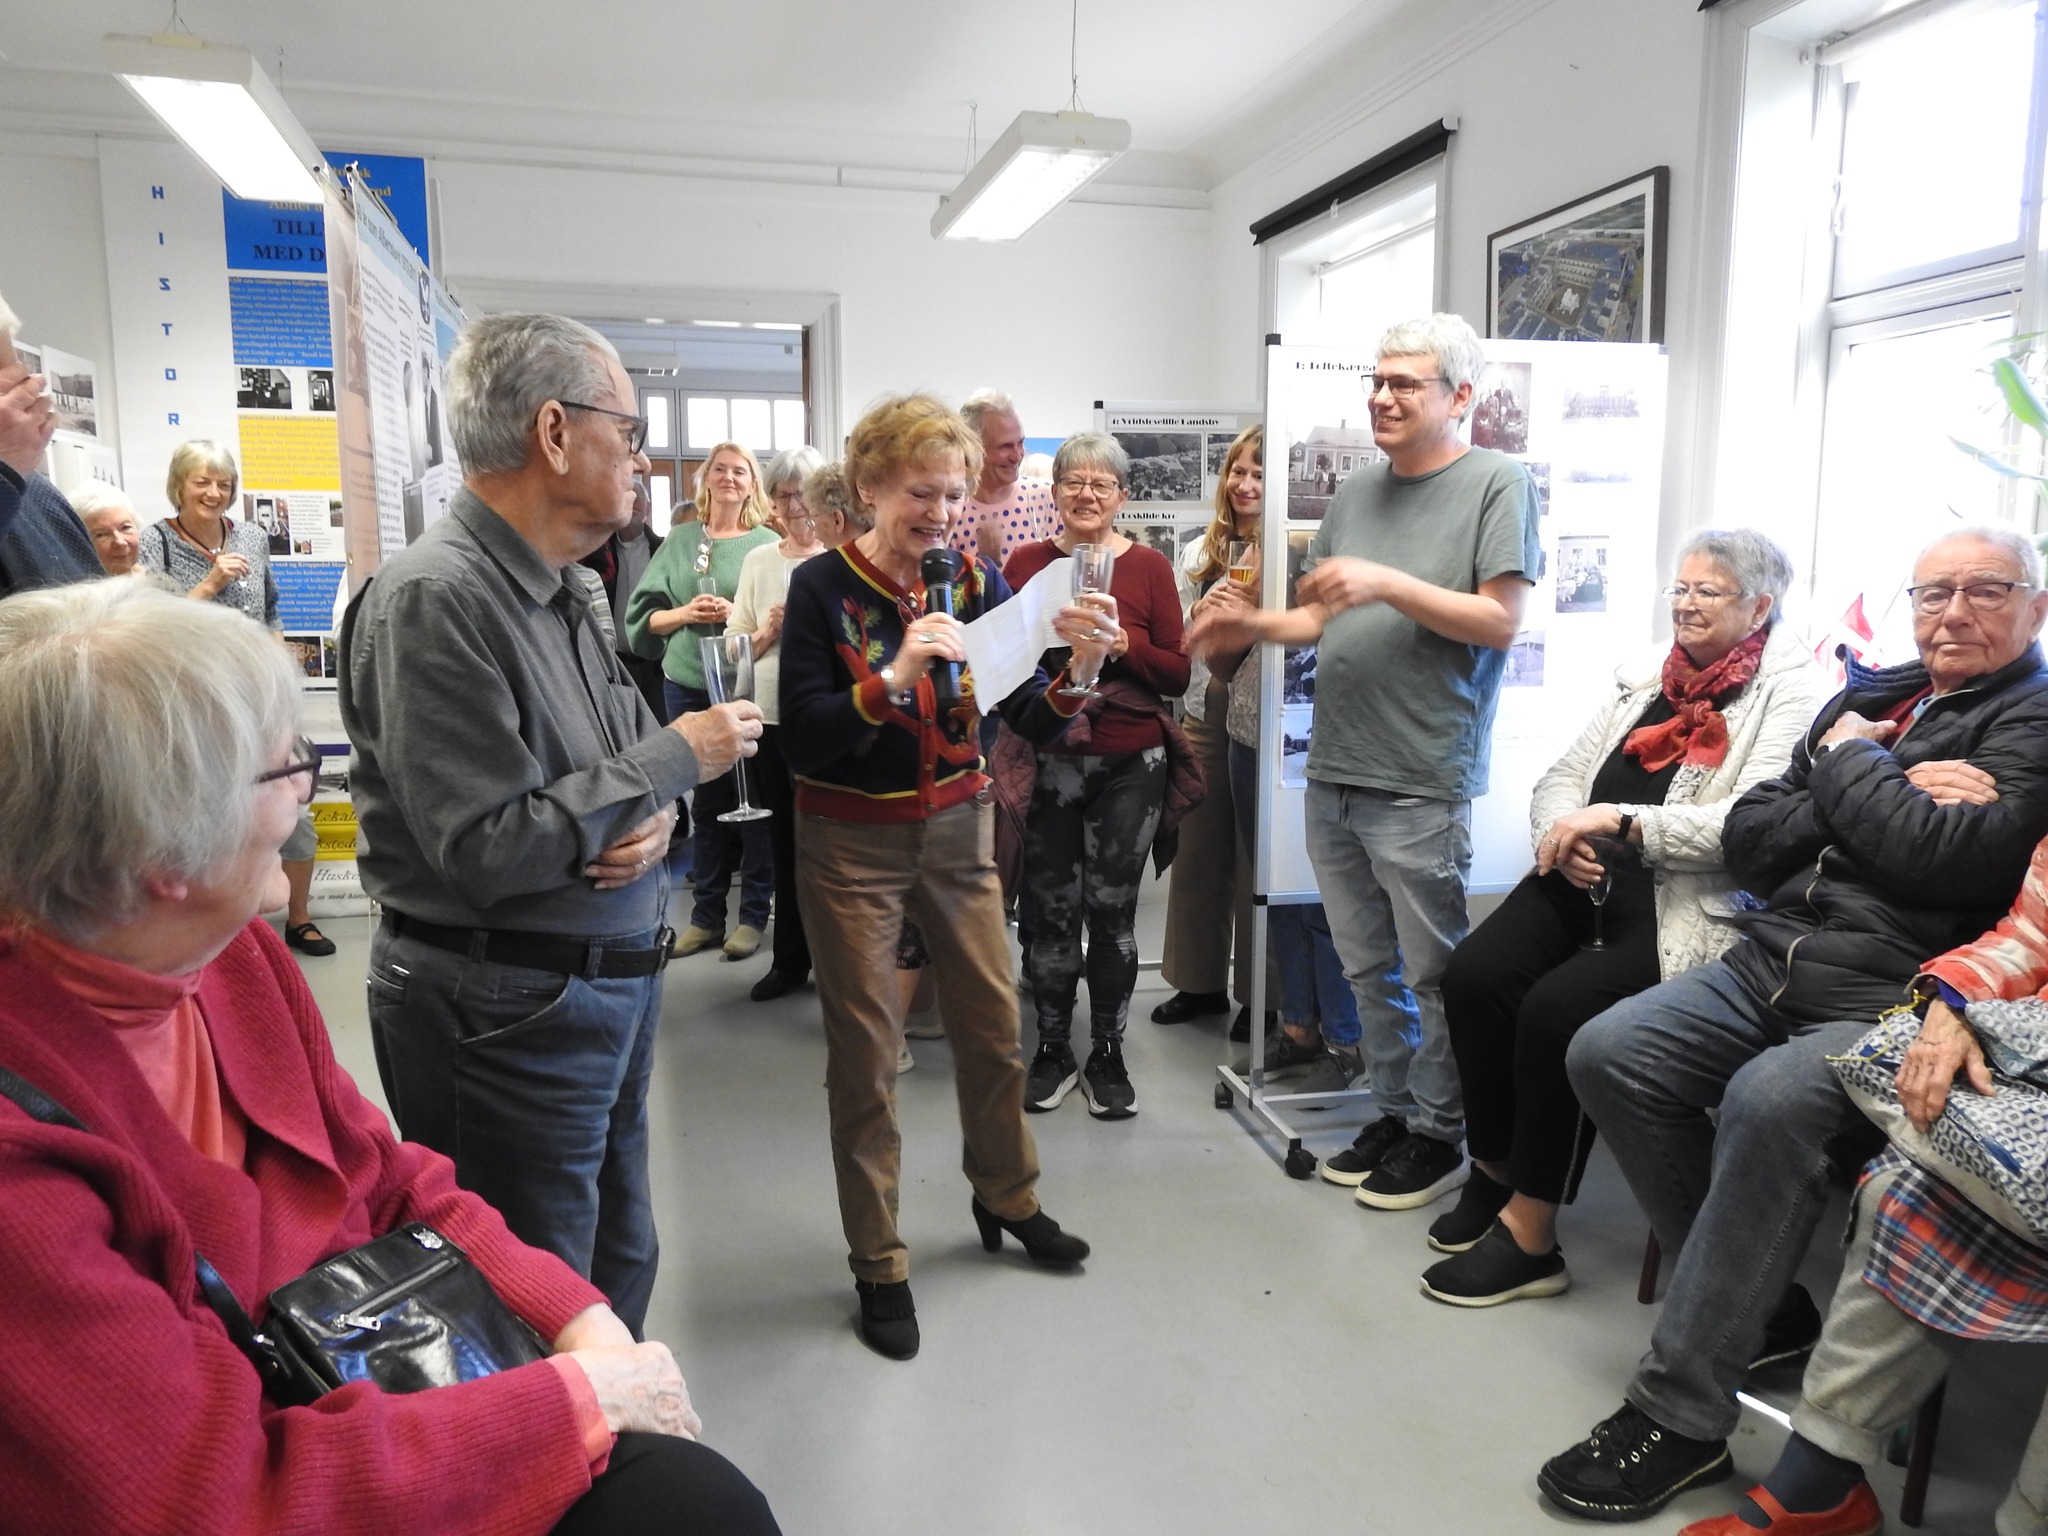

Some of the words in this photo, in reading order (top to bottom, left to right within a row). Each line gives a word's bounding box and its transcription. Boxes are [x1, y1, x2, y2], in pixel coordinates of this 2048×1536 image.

[272, 218, 325, 236] TILL
[253, 244, 303, 261] MED
[1181, 418, 1219, 426] Landsby
